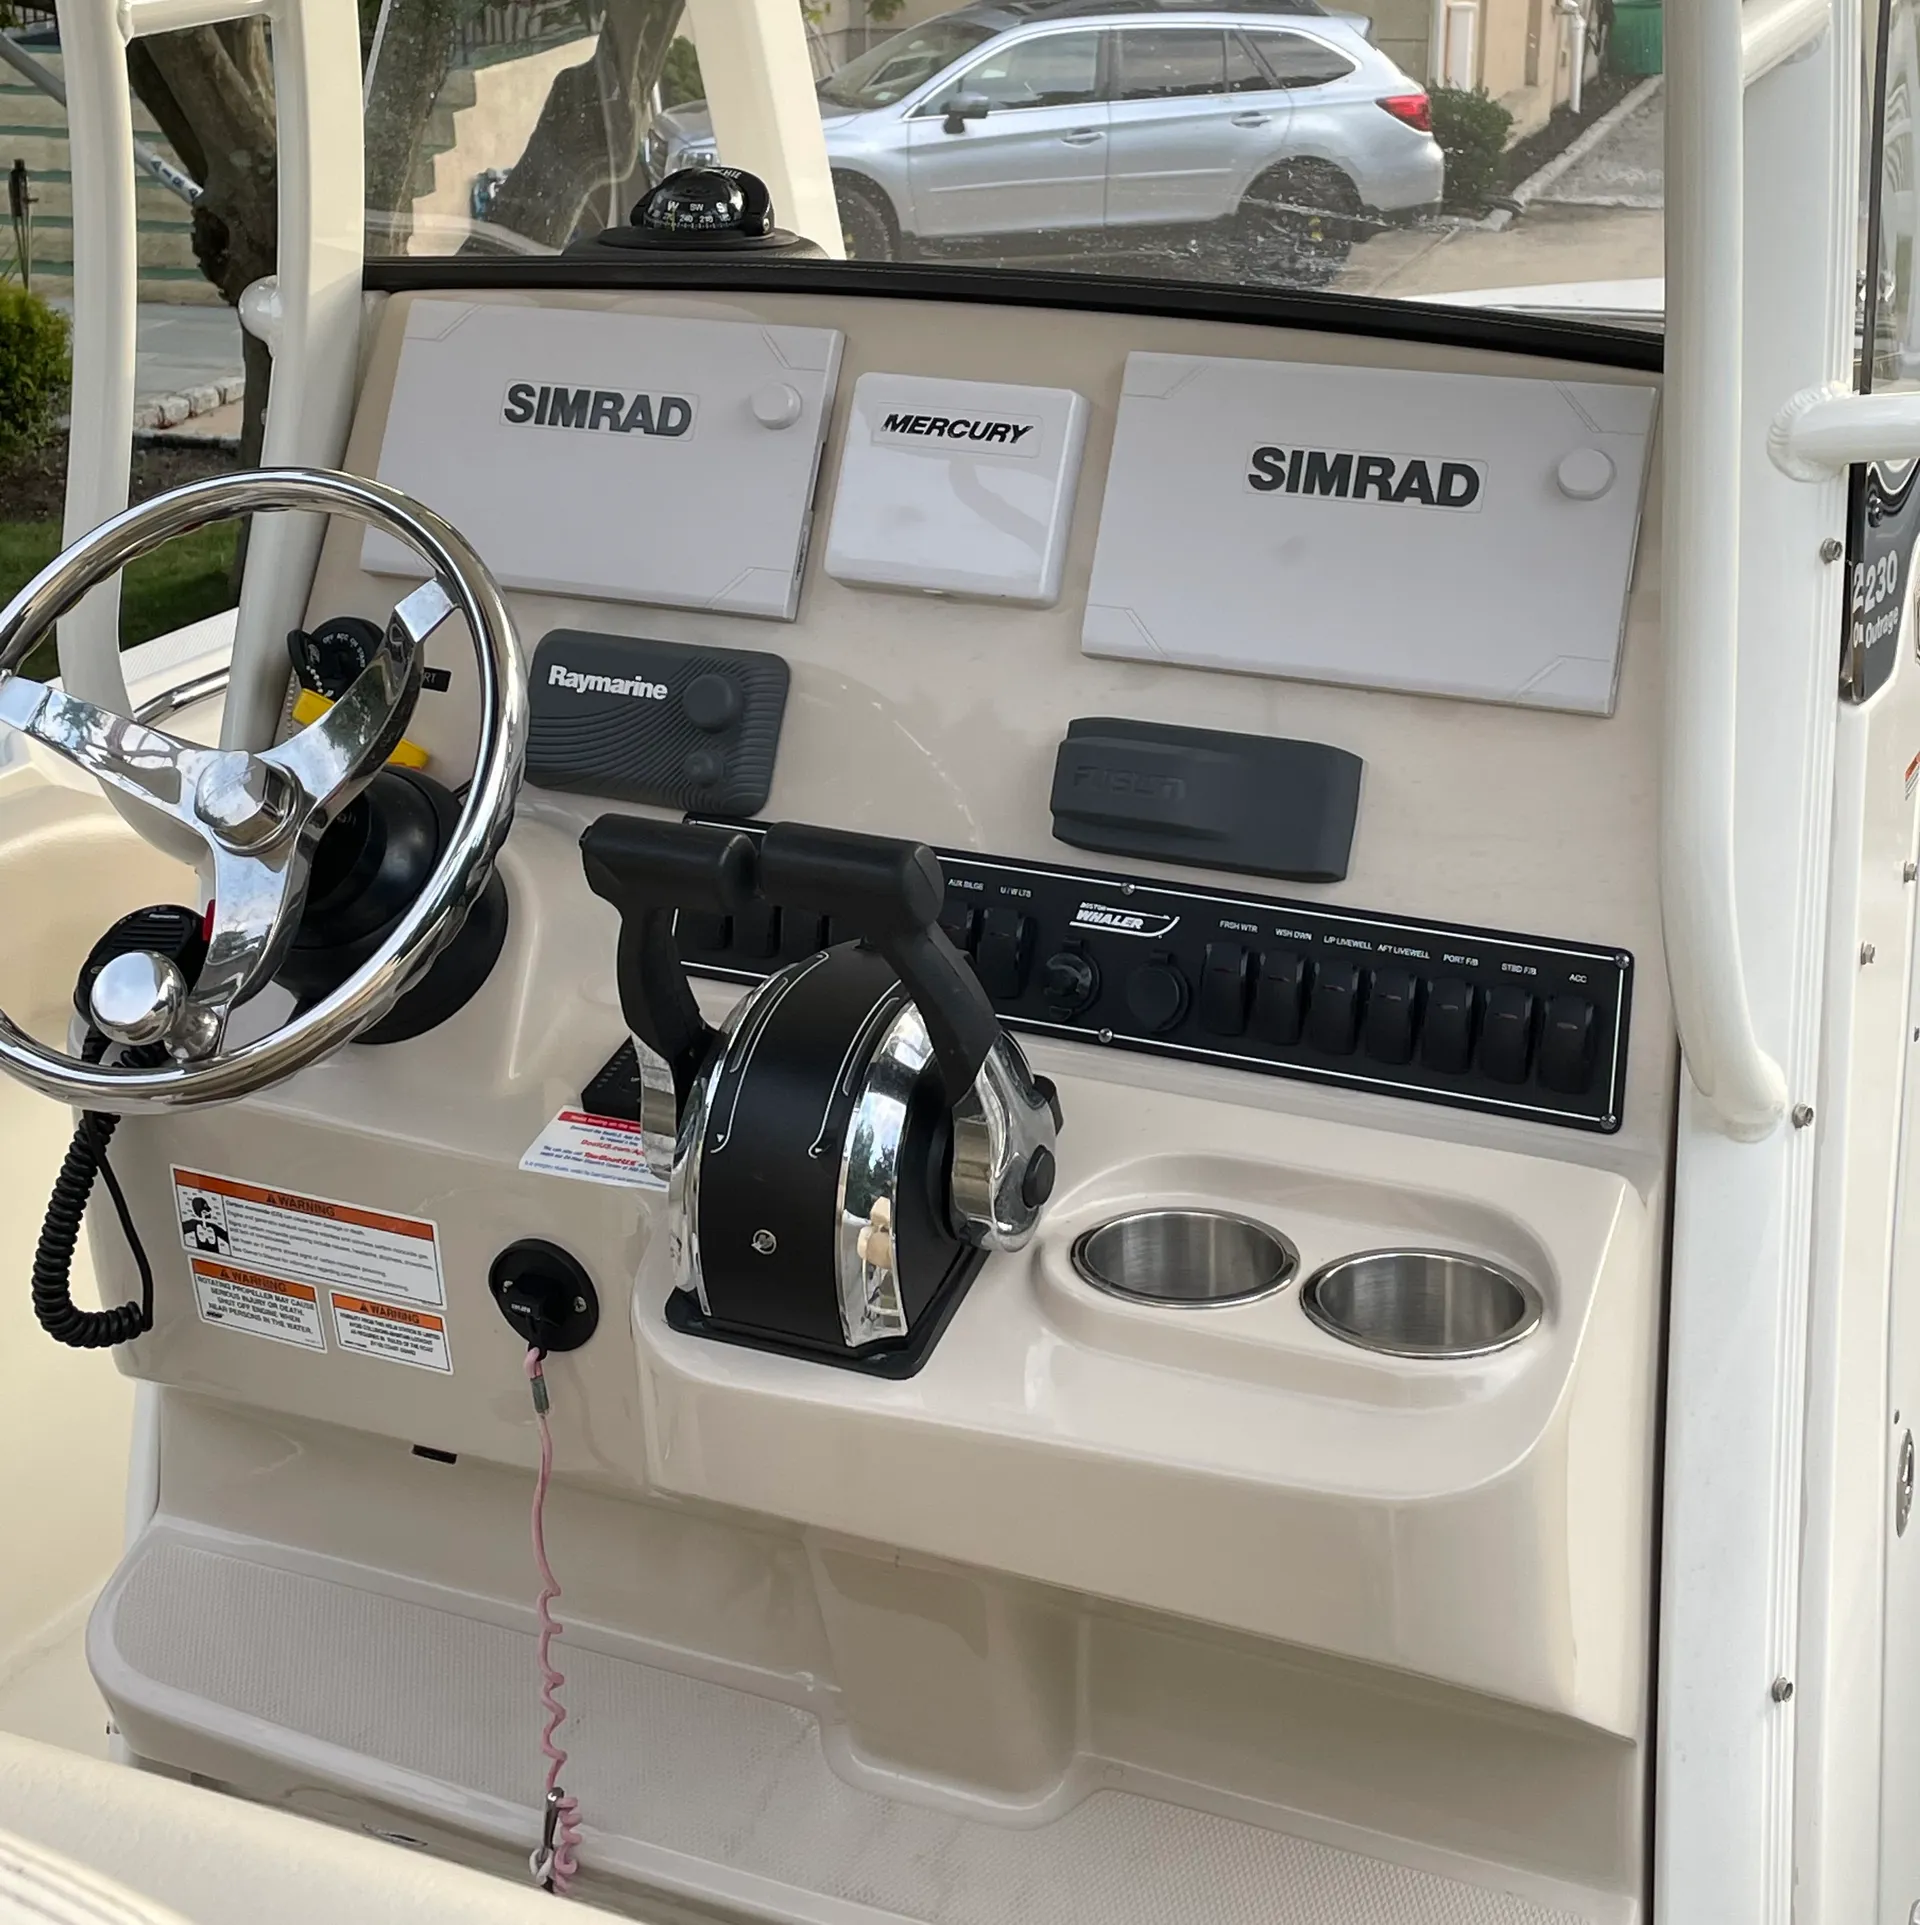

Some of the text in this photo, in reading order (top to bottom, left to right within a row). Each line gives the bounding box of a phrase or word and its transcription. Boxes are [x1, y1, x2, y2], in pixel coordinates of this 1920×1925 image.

[504, 383, 692, 438] SIMRAD
[881, 413, 1034, 444] MERCURY
[1248, 446, 1480, 508] SIMRAD
[548, 664, 668, 700] Raymarine
[948, 878, 963, 888] AUX
[1076, 910, 1144, 930] WHALER
[1220, 920, 1258, 933] FRSH WTR
[1275, 928, 1293, 938] WSH
[1336, 938, 1372, 950] LIVEWELL
[1377, 944, 1430, 959] AFT LIVEWELL
[1443, 954, 1464, 964] PORT
[1568, 973, 1588, 983] ACC
[277, 1194, 335, 1217] WARNING
[231, 1271, 287, 1292] WARNING
[369, 1304, 420, 1324] WARNING
